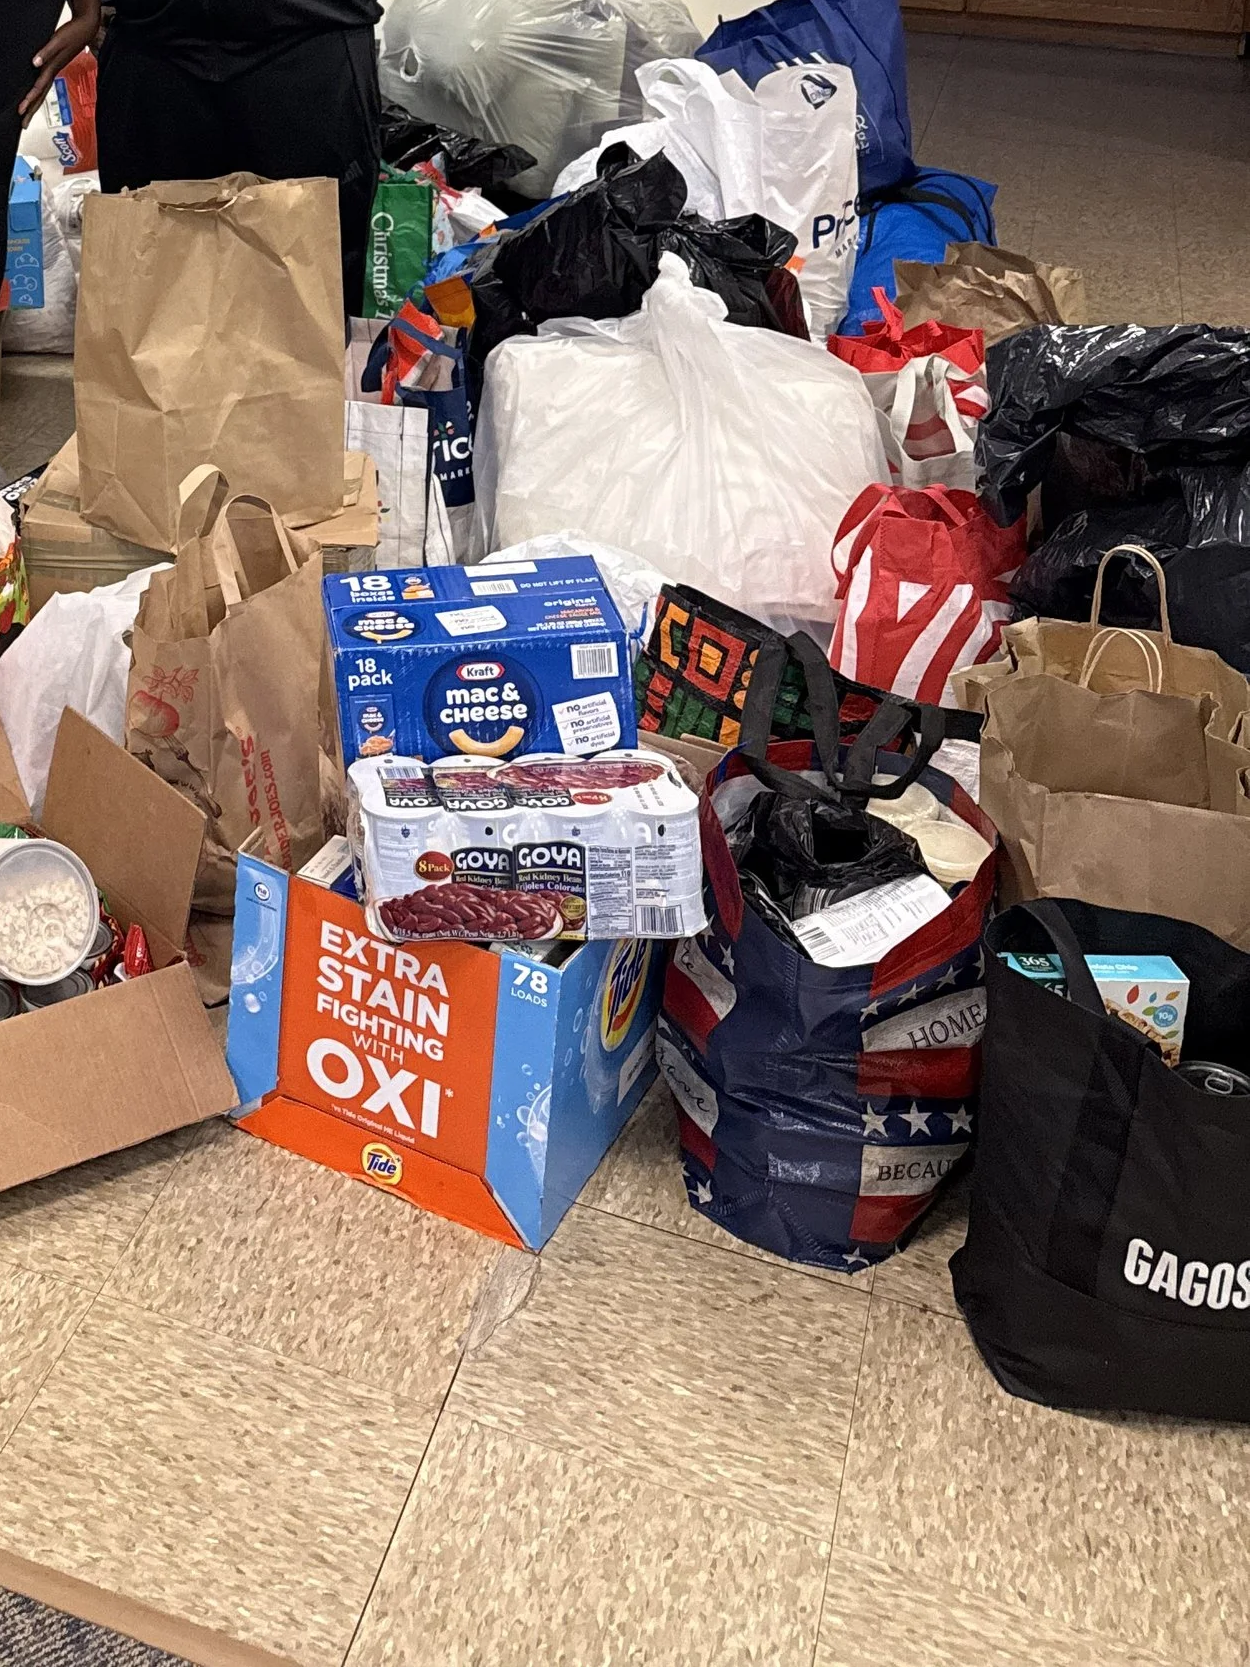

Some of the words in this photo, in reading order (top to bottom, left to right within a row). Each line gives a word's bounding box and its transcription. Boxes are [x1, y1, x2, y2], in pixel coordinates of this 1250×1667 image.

[54, 134, 77, 163] Scott
[371, 211, 394, 315] Christmas
[439, 464, 472, 483] MARK
[340, 575, 391, 592] 18
[544, 596, 597, 607] original
[355, 658, 377, 674] 18
[466, 665, 495, 677] Kraft
[348, 669, 393, 691] pack
[446, 686, 498, 704] mac
[501, 682, 520, 701] &
[566, 704, 581, 713] no
[582, 699, 607, 709] artificial
[578, 708, 599, 716] flavors
[570, 719, 585, 728] no
[586, 715, 611, 725] artificial
[573, 721, 613, 734] preservatives
[575, 735, 589, 745] no
[590, 731, 615, 741] artificial
[446, 799, 508, 810] GOYA
[455, 851, 510, 871] GOYA
[518, 846, 581, 867] GOYA
[418, 860, 427, 873] 8
[427, 864, 450, 873] Pack
[456, 875, 466, 883] Red
[467, 875, 493, 884] Kidney
[518, 874, 531, 883] Red
[532, 873, 561, 883] Kidney
[562, 874, 582, 884] Beans
[320, 920, 449, 998] EXTRA
[1019, 955, 1051, 967] 365
[1115, 963, 1139, 972] Chip
[512, 963, 549, 995] 78
[316, 956, 450, 1036] STAIN
[510, 986, 548, 1008] LOADS
[907, 1002, 988, 1050] HOME
[1158, 1011, 1173, 1022] 10g
[316, 993, 444, 1061] FIGHTING
[352, 1030, 404, 1065] WITH
[342, 1107, 356, 1119] Tide
[357, 1114, 383, 1131] Original
[394, 1130, 415, 1144] Liquid
[366, 1151, 397, 1175] Tide
[876, 1157, 954, 1183] BECAU
[1123, 1237, 1250, 1311] GAGOS
